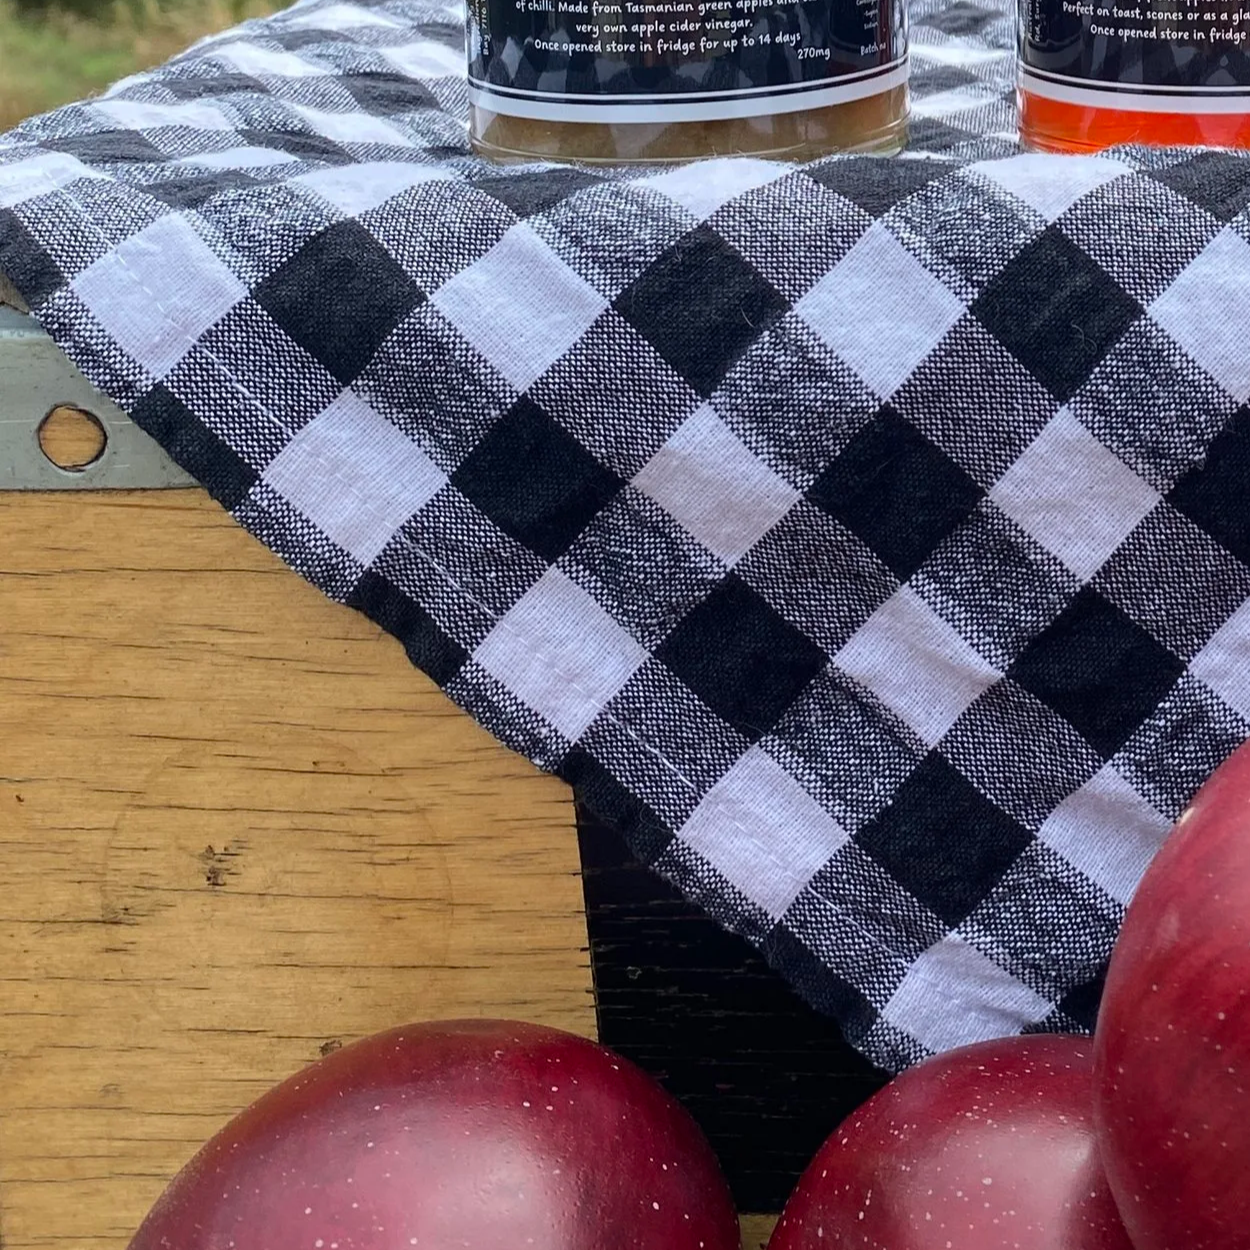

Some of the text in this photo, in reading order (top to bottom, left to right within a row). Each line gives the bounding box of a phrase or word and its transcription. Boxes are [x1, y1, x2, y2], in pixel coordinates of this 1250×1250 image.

[528, 0, 555, 12] chilli.
[558, 1, 589, 14] Made
[592, 1, 622, 16] from
[625, 2, 694, 13] Tasmanian
[698, 2, 732, 16] green
[1063, 0, 1094, 17] Perfect
[1096, 7, 1110, 17] on
[1112, 6, 1143, 21] toast,
[1146, 10, 1183, 21] scones
[1187, 11, 1200, 21] or
[1203, 12, 1217, 21] as
[1220, 11, 1229, 21] a
[575, 18, 753, 38] very own apple cider vinegar.
[797, 47, 831, 61] 270mg
